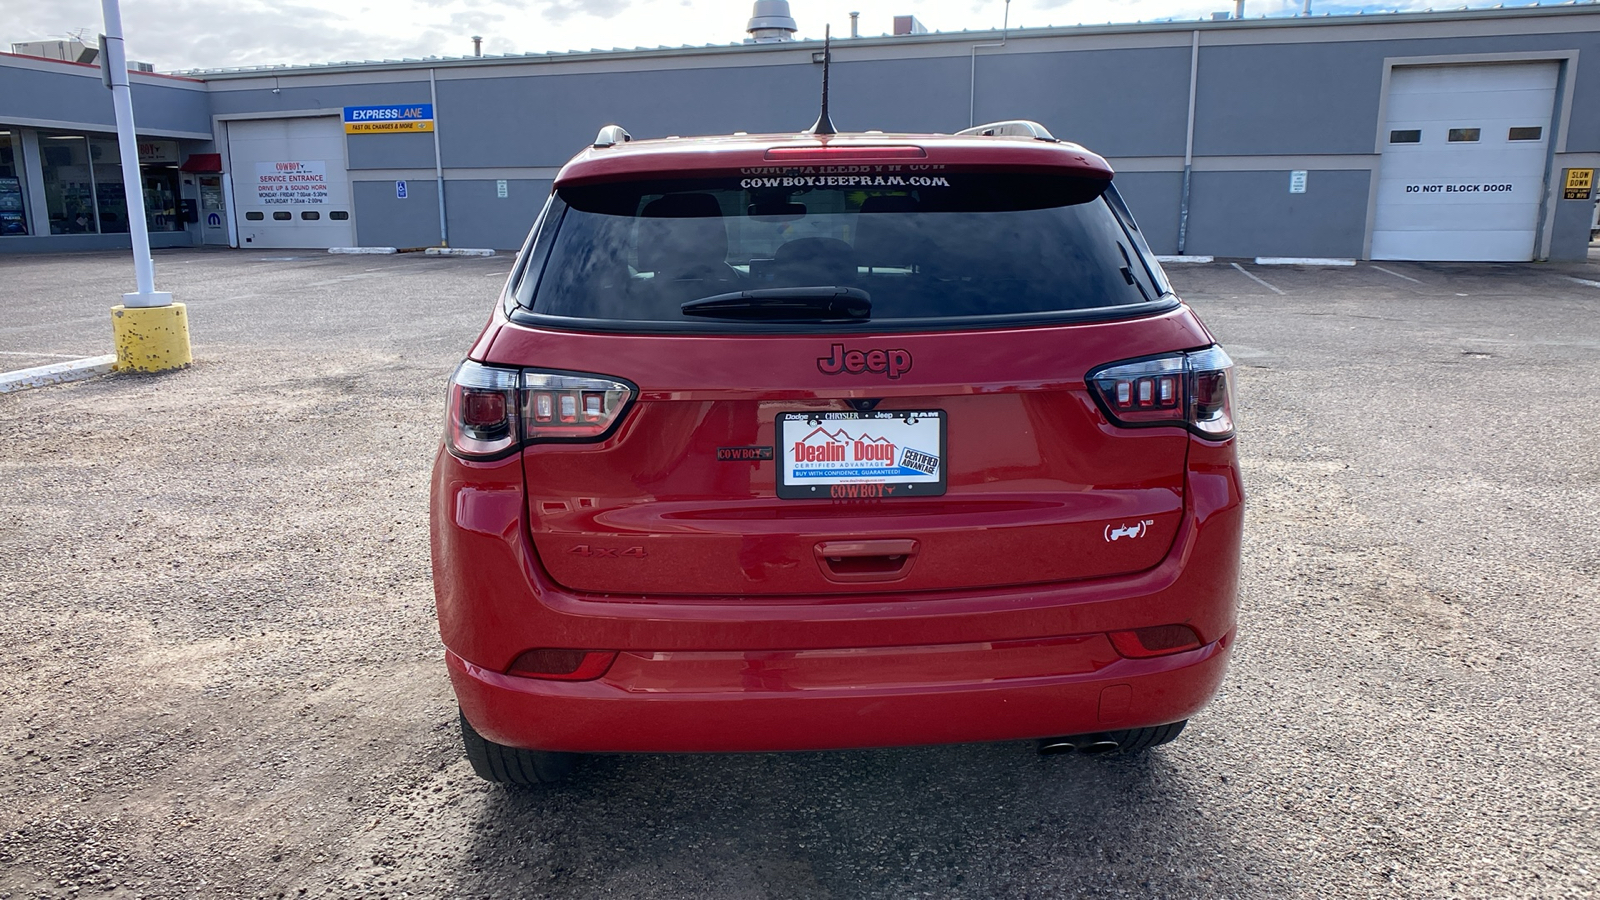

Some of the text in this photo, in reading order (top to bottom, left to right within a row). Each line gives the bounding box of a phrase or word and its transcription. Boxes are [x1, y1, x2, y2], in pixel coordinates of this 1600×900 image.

[276, 162, 300, 171] COWBOY
[260, 174, 323, 183] SERVICE ENTRANCE
[1572, 171, 1590, 179] SLOW
[740, 175, 950, 189] COWBOYJEEPRAM.COM
[1569, 179, 1588, 187] DOWN
[1406, 184, 1513, 193] DO NOT BLOCK DOOR
[817, 343, 913, 380] Jeep
[785, 413, 809, 421] Dodge
[825, 412, 859, 420] CHRYSLER
[874, 411, 893, 420] Jeep
[719, 448, 762, 459] COWBOY
[794, 440, 895, 467] Dealin' Doug
[904, 449, 939, 468] CERTIFIED
[901, 458, 936, 475] ADVANTAGE
[830, 483, 885, 499] COWBOY
[566, 544, 649, 559] 4x4
